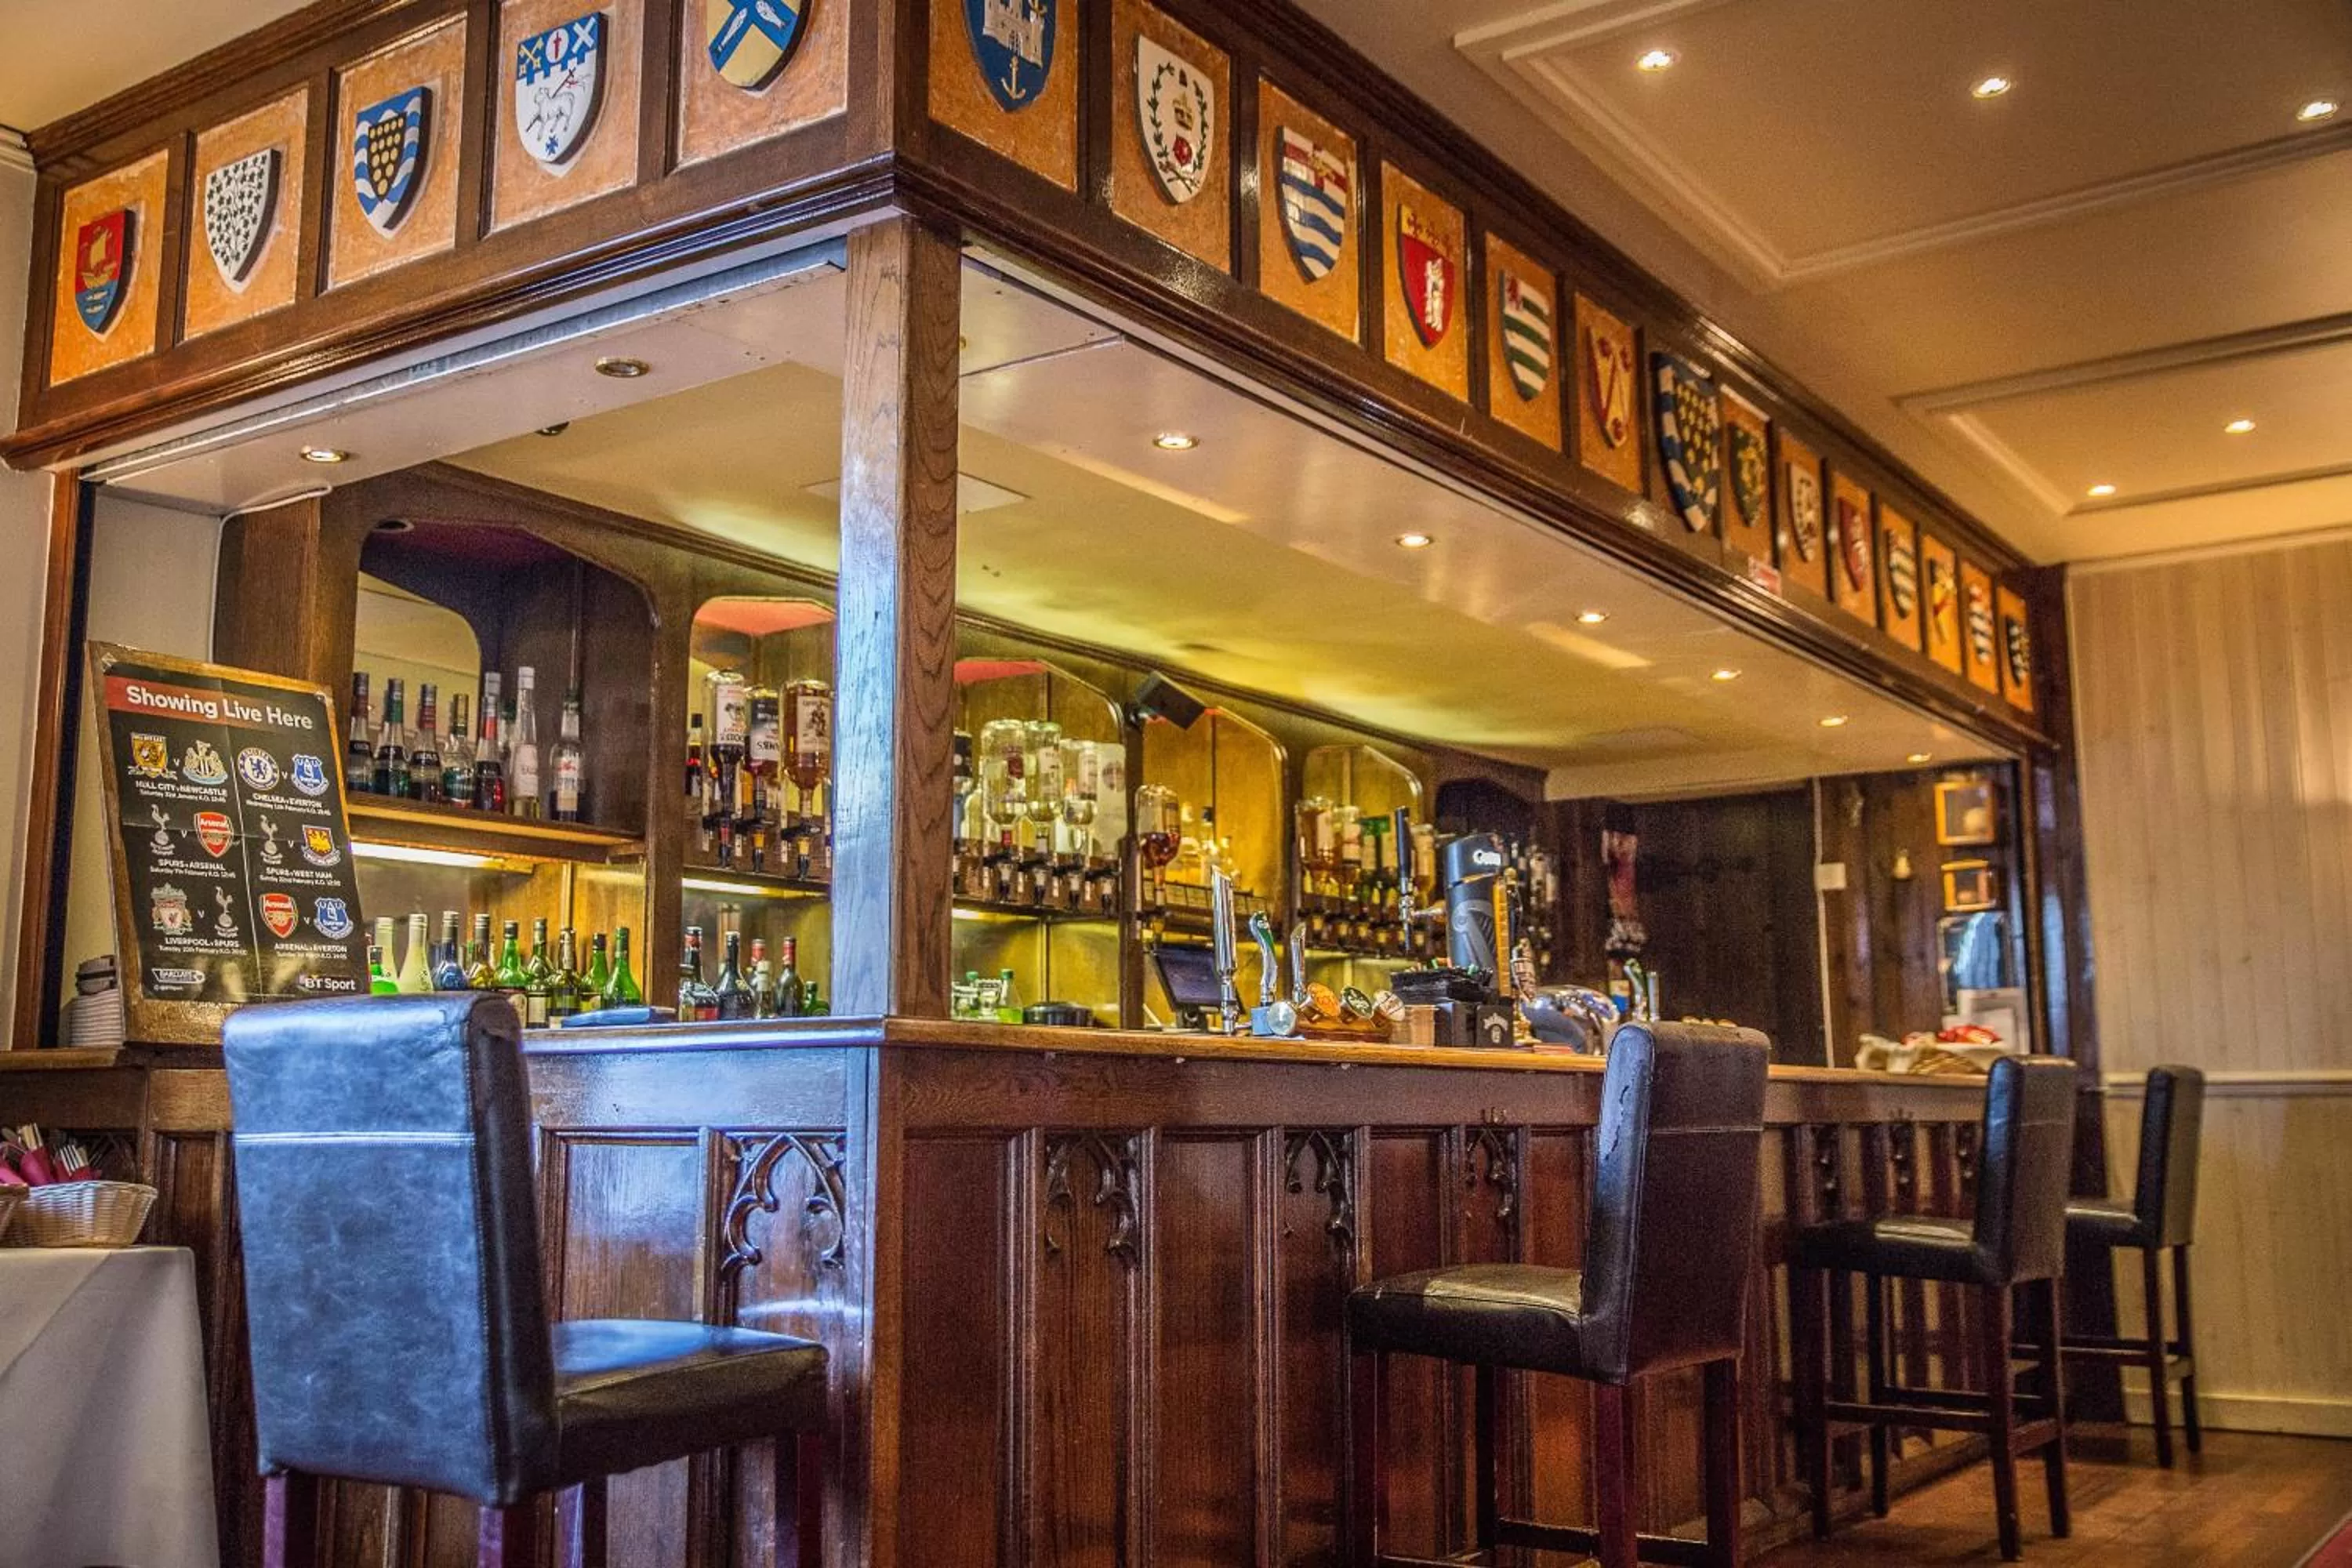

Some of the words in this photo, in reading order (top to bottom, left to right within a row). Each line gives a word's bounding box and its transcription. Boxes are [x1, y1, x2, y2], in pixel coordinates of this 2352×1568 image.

[126, 684, 217, 719] Showing
[223, 698, 263, 722] Live
[266, 706, 314, 730] Here
[136, 780, 157, 789] HULL
[158, 782, 176, 791] CITY
[180, 785, 227, 797] NEWCASTLE
[252, 793, 285, 802] CHELSEA
[289, 797, 322, 807] EVERTON
[158, 858, 184, 868] SPURS
[189, 861, 226, 870] ARSENAL
[267, 867, 290, 876] SPURS
[165, 937, 210, 946] LIVERPOOL
[274, 942, 310, 951] ARSENAL
[313, 944, 347, 953] EVERTON
[305, 977, 323, 989] BT
[324, 978, 356, 991] Sport
